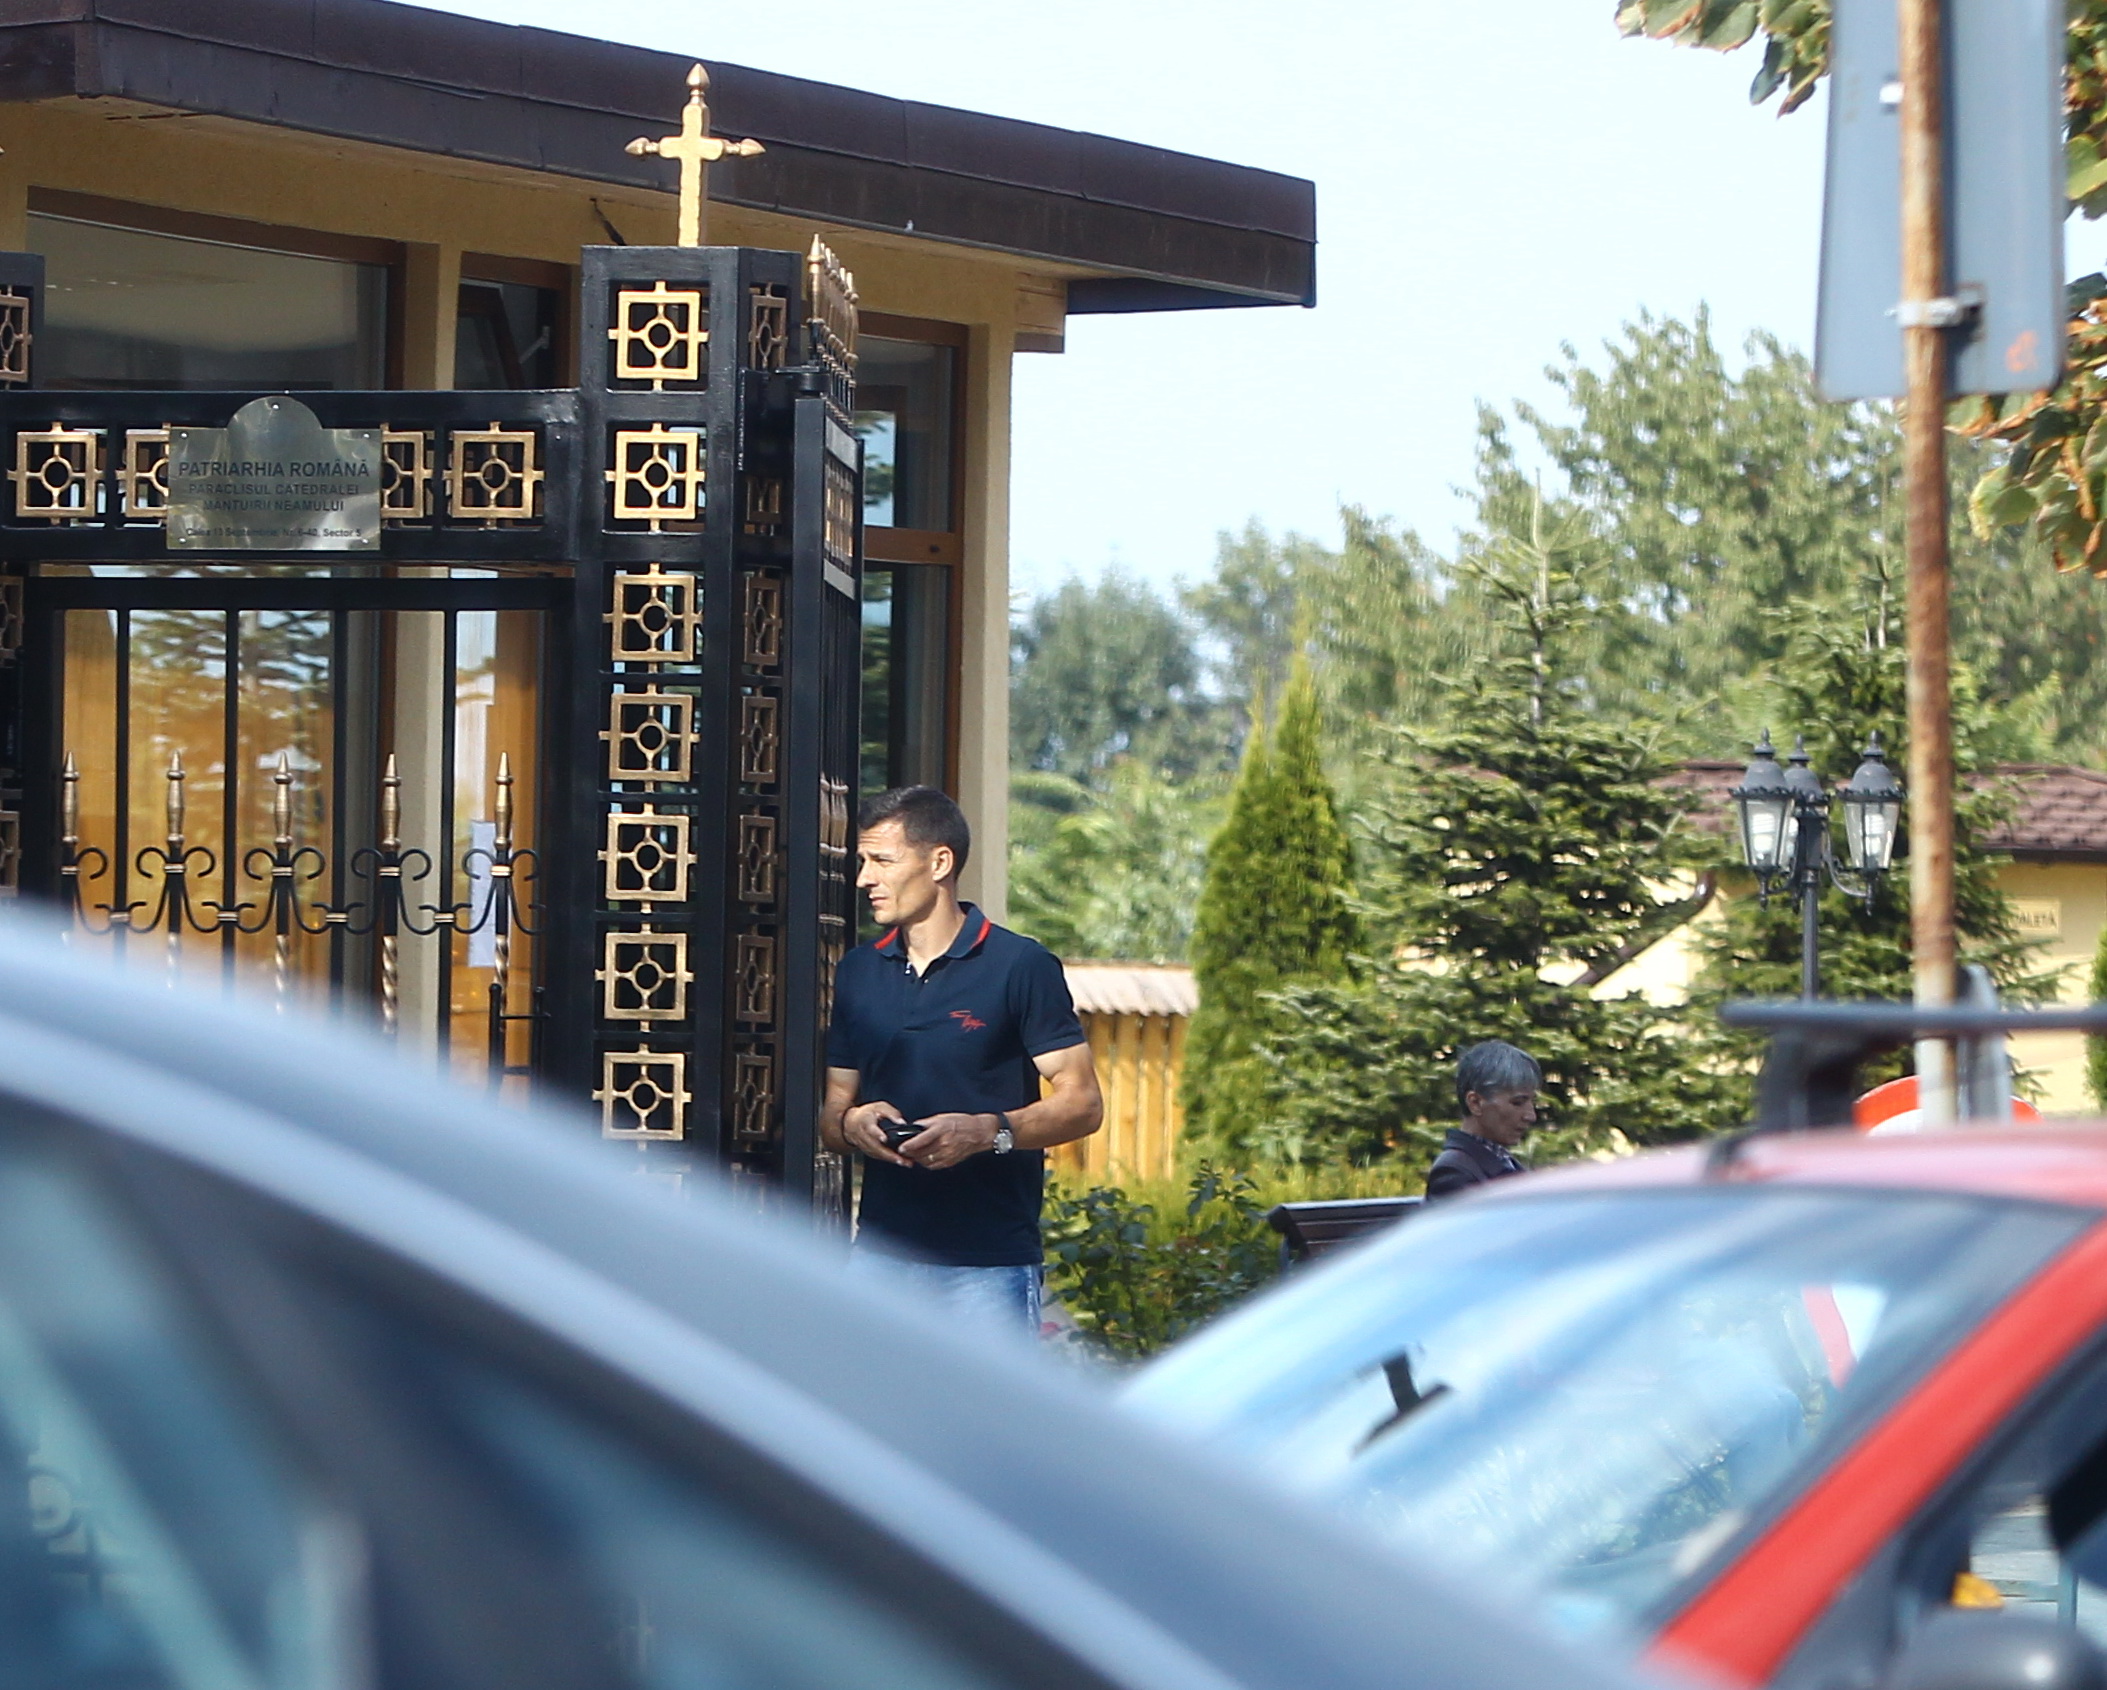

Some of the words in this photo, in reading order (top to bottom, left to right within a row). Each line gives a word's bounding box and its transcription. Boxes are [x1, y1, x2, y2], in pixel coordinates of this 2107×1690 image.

[179, 461, 284, 477] PATRIARHIA
[189, 484, 271, 495] PARACLISUL
[275, 484, 359, 495] CATEDRALEI
[274, 500, 344, 511] NEAMULUI
[323, 528, 354, 537] Sector
